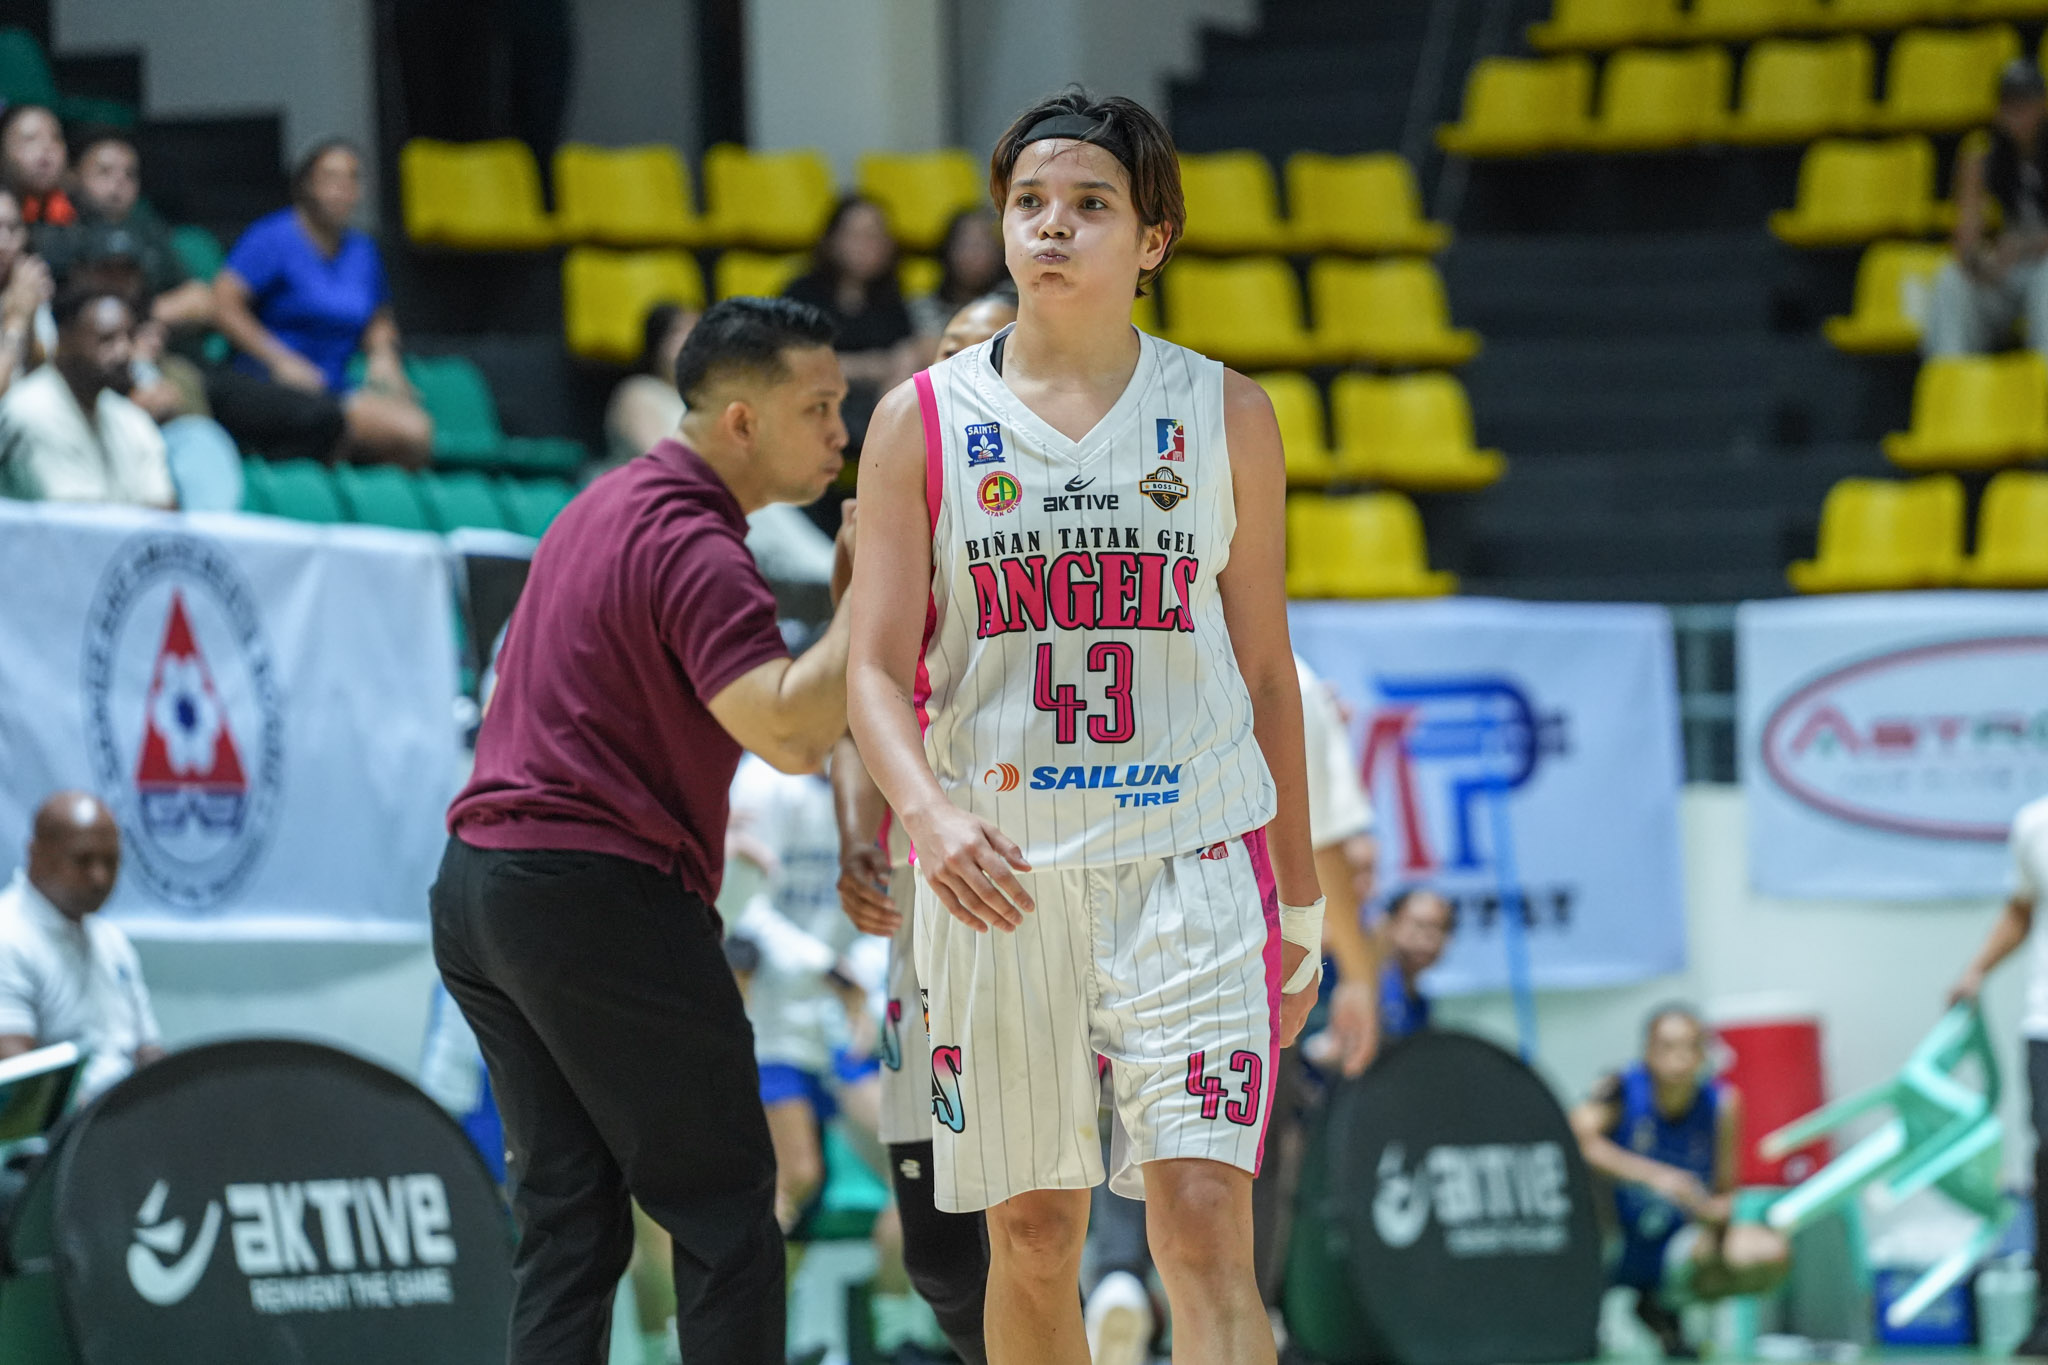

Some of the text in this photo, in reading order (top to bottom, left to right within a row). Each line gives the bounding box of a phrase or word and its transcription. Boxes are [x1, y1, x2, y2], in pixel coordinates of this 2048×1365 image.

[968, 424, 998, 436] SAINTS
[983, 502, 1020, 517] TATAK GEL
[966, 527, 1195, 561] BIÑAN TATAK GEL
[968, 551, 1199, 639] ANGELS
[1033, 642, 1135, 744] 43
[1029, 763, 1183, 790] SAILUN
[1114, 789, 1180, 808] TIRE
[1186, 1049, 1262, 1126] 43
